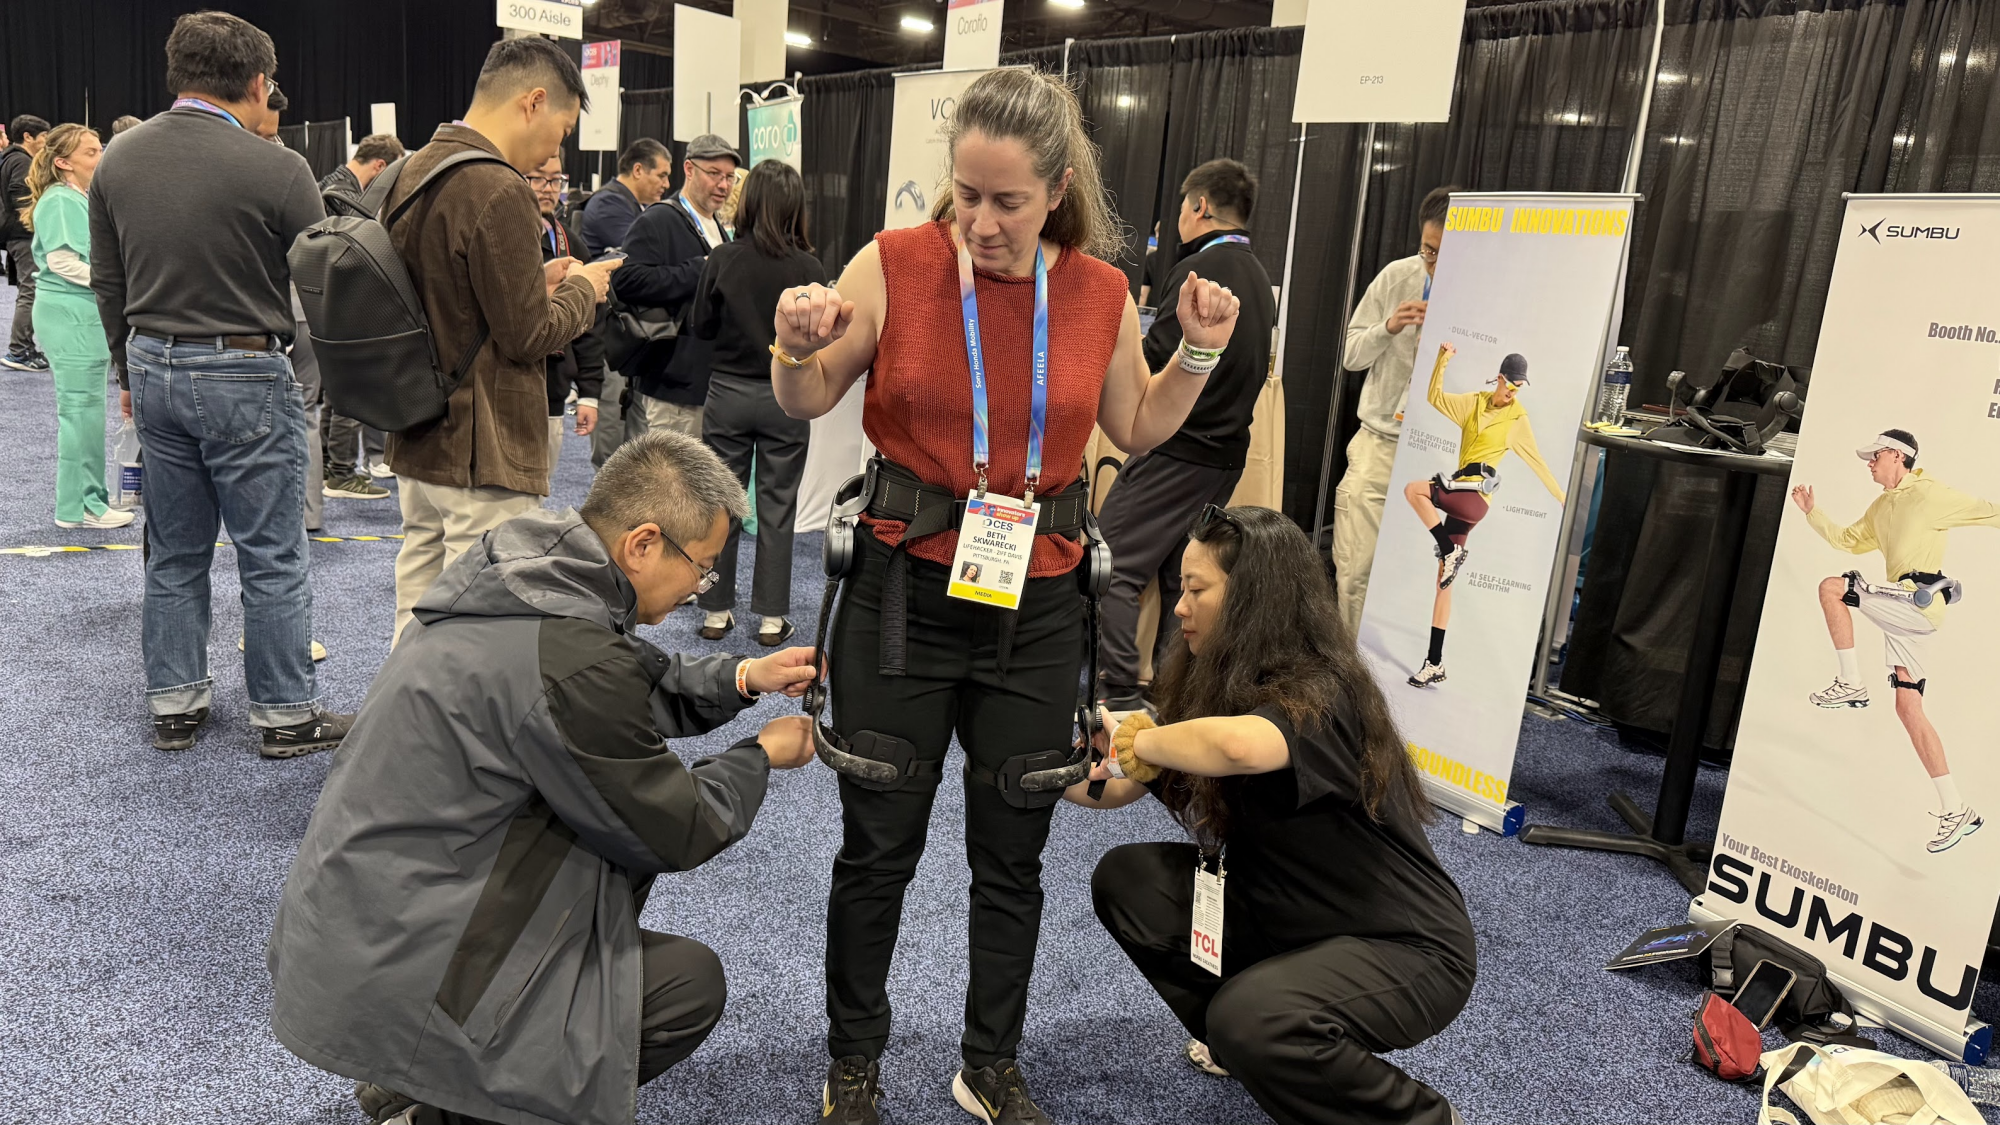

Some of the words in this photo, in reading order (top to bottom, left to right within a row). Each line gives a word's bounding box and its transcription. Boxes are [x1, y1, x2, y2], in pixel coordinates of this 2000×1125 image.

[509, 4, 536, 21] 300
[539, 10, 571, 26] Aisle
[957, 14, 988, 35] Coroflo
[1360, 75, 1384, 84] EP-213
[1445, 206, 1505, 233] SUMBU
[1510, 207, 1628, 237] INNOVATIONS
[1886, 225, 1960, 240] SUMBU
[968, 318, 976, 347] Mobility
[1451, 326, 1498, 345] DUAL-VECTOR
[1928, 322, 1973, 341] Booth
[972, 347, 980, 370] Honda
[1036, 351, 1045, 386] AFEELA
[1407, 441, 1427, 452] MOTOR
[1409, 435, 1441, 451] PLANETARY
[1442, 444, 1456, 455] GEAR
[1410, 428, 1457, 448] SELF-DEVELOPED
[1505, 505, 1547, 519] LIGHTWEIGHT
[993, 520, 1013, 531] CES
[972, 536, 1016, 551] SKWARECKI
[986, 531, 1006, 540] BETH
[963, 543, 993, 554] LIFEHACKER
[1468, 579, 1510, 594] ALGORITHM
[1469, 571, 1478, 579] AI
[1479, 573, 1532, 591] SELF-LEARNING
[974, 590, 992, 598] MEDIA
[1722, 832, 1750, 856] Your
[1750, 846, 1778, 870] Best
[1779, 858, 1859, 906] Exoskeleton
[1708, 853, 1979, 1011] SUMBU
[1193, 929, 1218, 958] TCL
